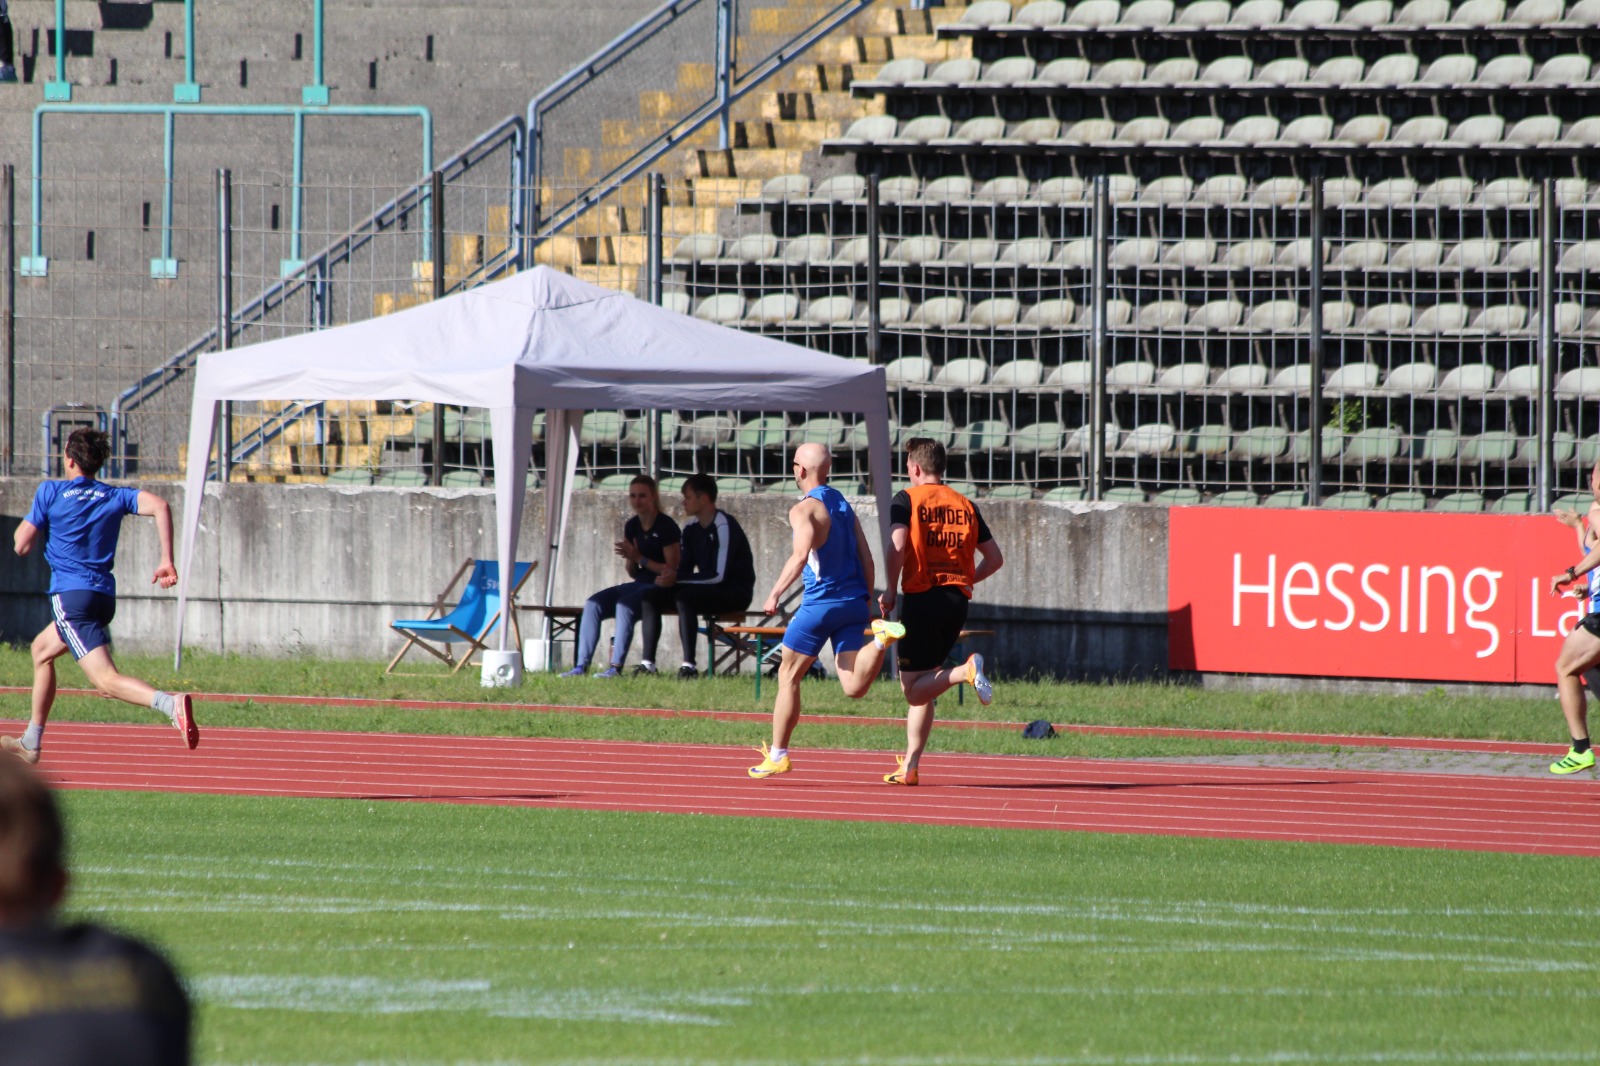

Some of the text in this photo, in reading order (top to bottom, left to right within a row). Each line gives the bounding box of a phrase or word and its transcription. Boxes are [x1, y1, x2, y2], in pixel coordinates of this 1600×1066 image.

[920, 506, 973, 526] BLINDEN
[926, 531, 965, 549] GUIDE
[1232, 552, 1503, 659] Hessing
